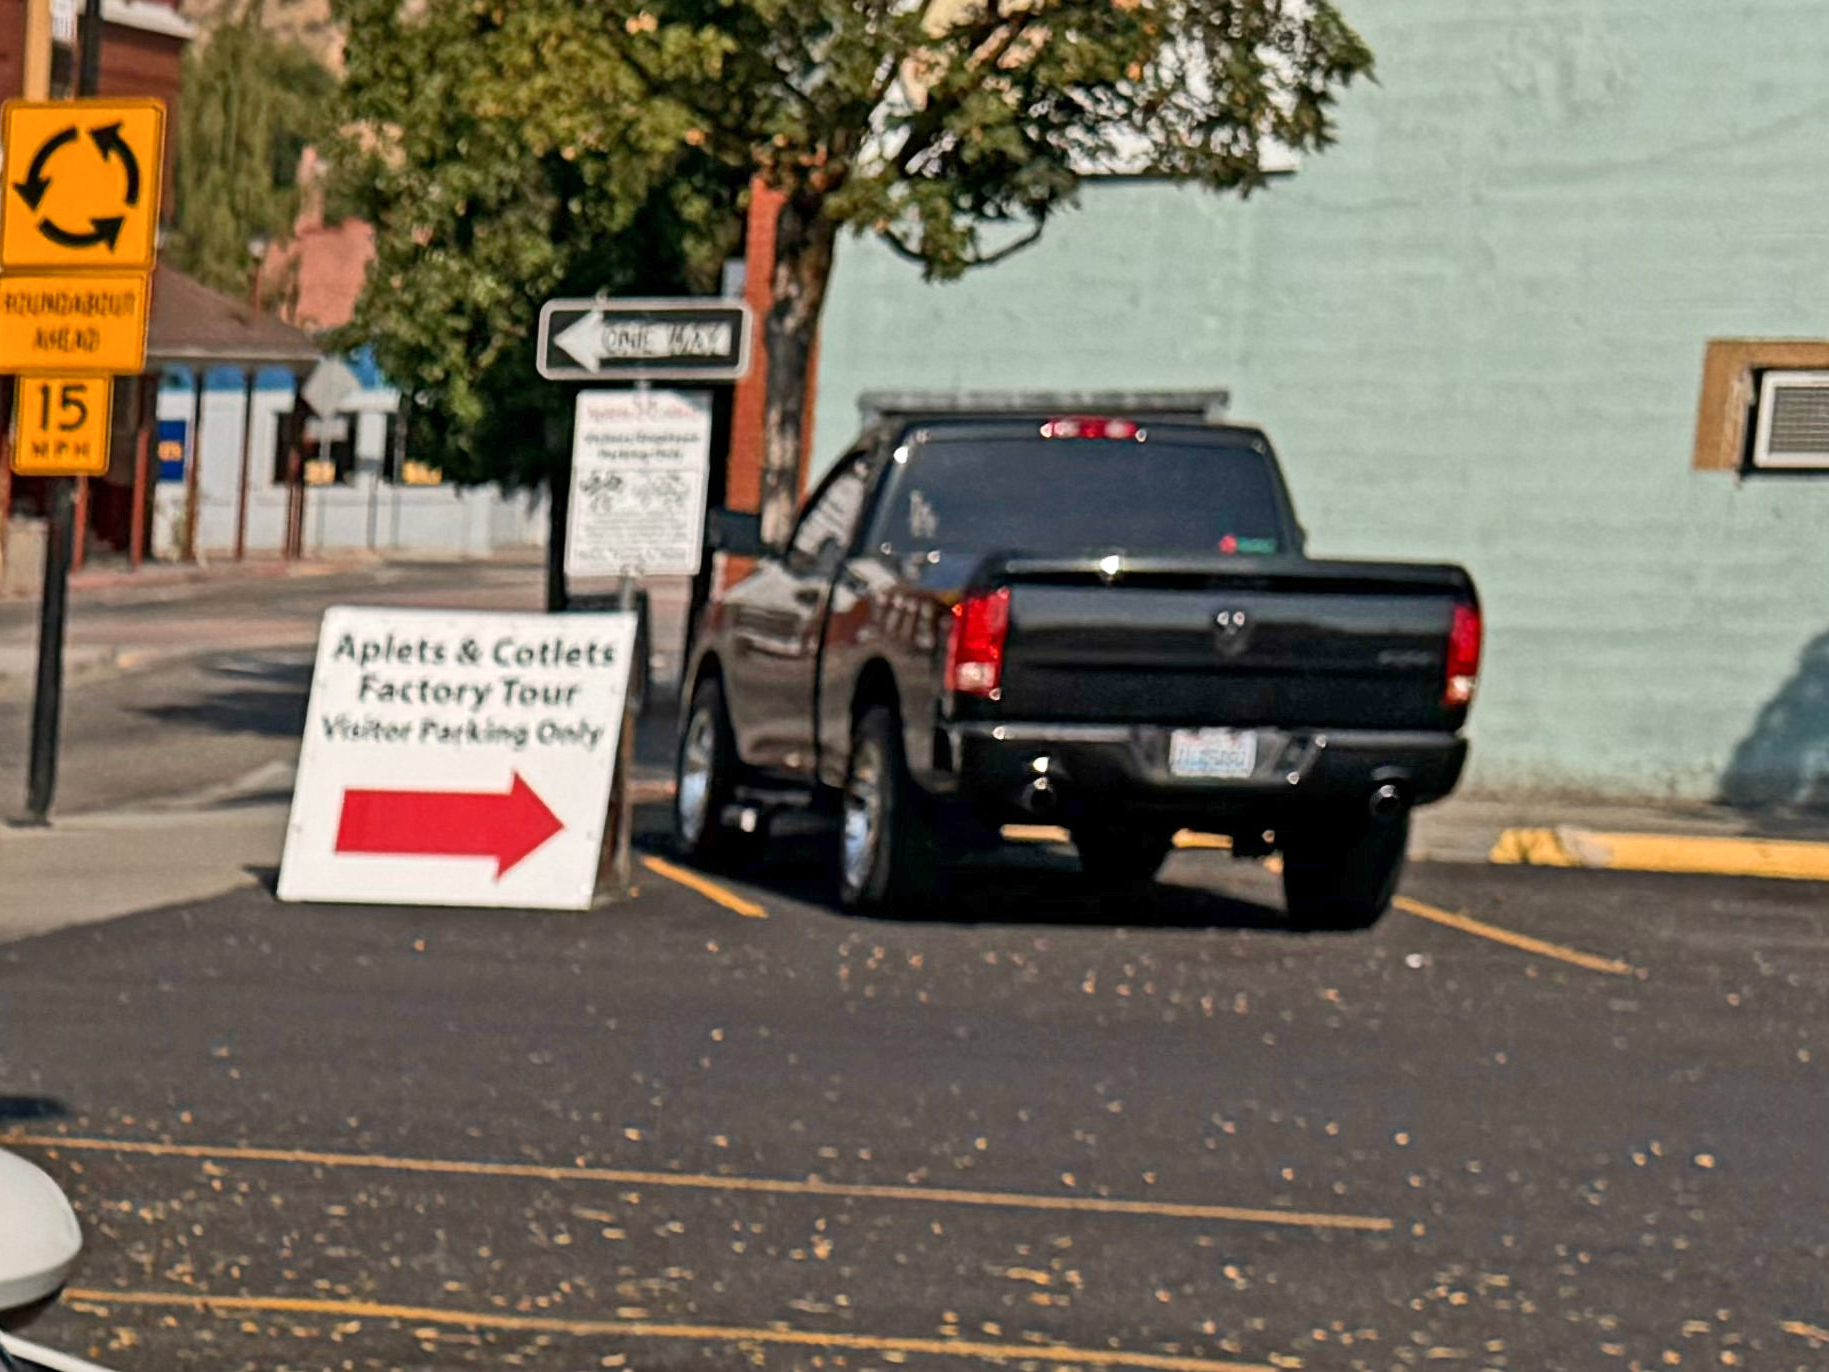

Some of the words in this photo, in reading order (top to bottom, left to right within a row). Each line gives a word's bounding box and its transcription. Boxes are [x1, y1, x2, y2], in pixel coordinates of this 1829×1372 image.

[5, 290, 136, 318] ROUNDABOUT
[34, 325, 100, 352] AHEAD
[602, 327, 654, 355] ONE
[668, 322, 723, 355] WAY
[40, 382, 87, 433] 15
[334, 633, 445, 667] Aplets
[457, 637, 483, 664] &
[492, 637, 617, 667] Cotlets
[358, 673, 491, 712] Factory
[502, 679, 580, 706] Tour
[321, 714, 412, 743] Visitor
[418, 717, 529, 750] Parking
[536, 719, 605, 749] Only
